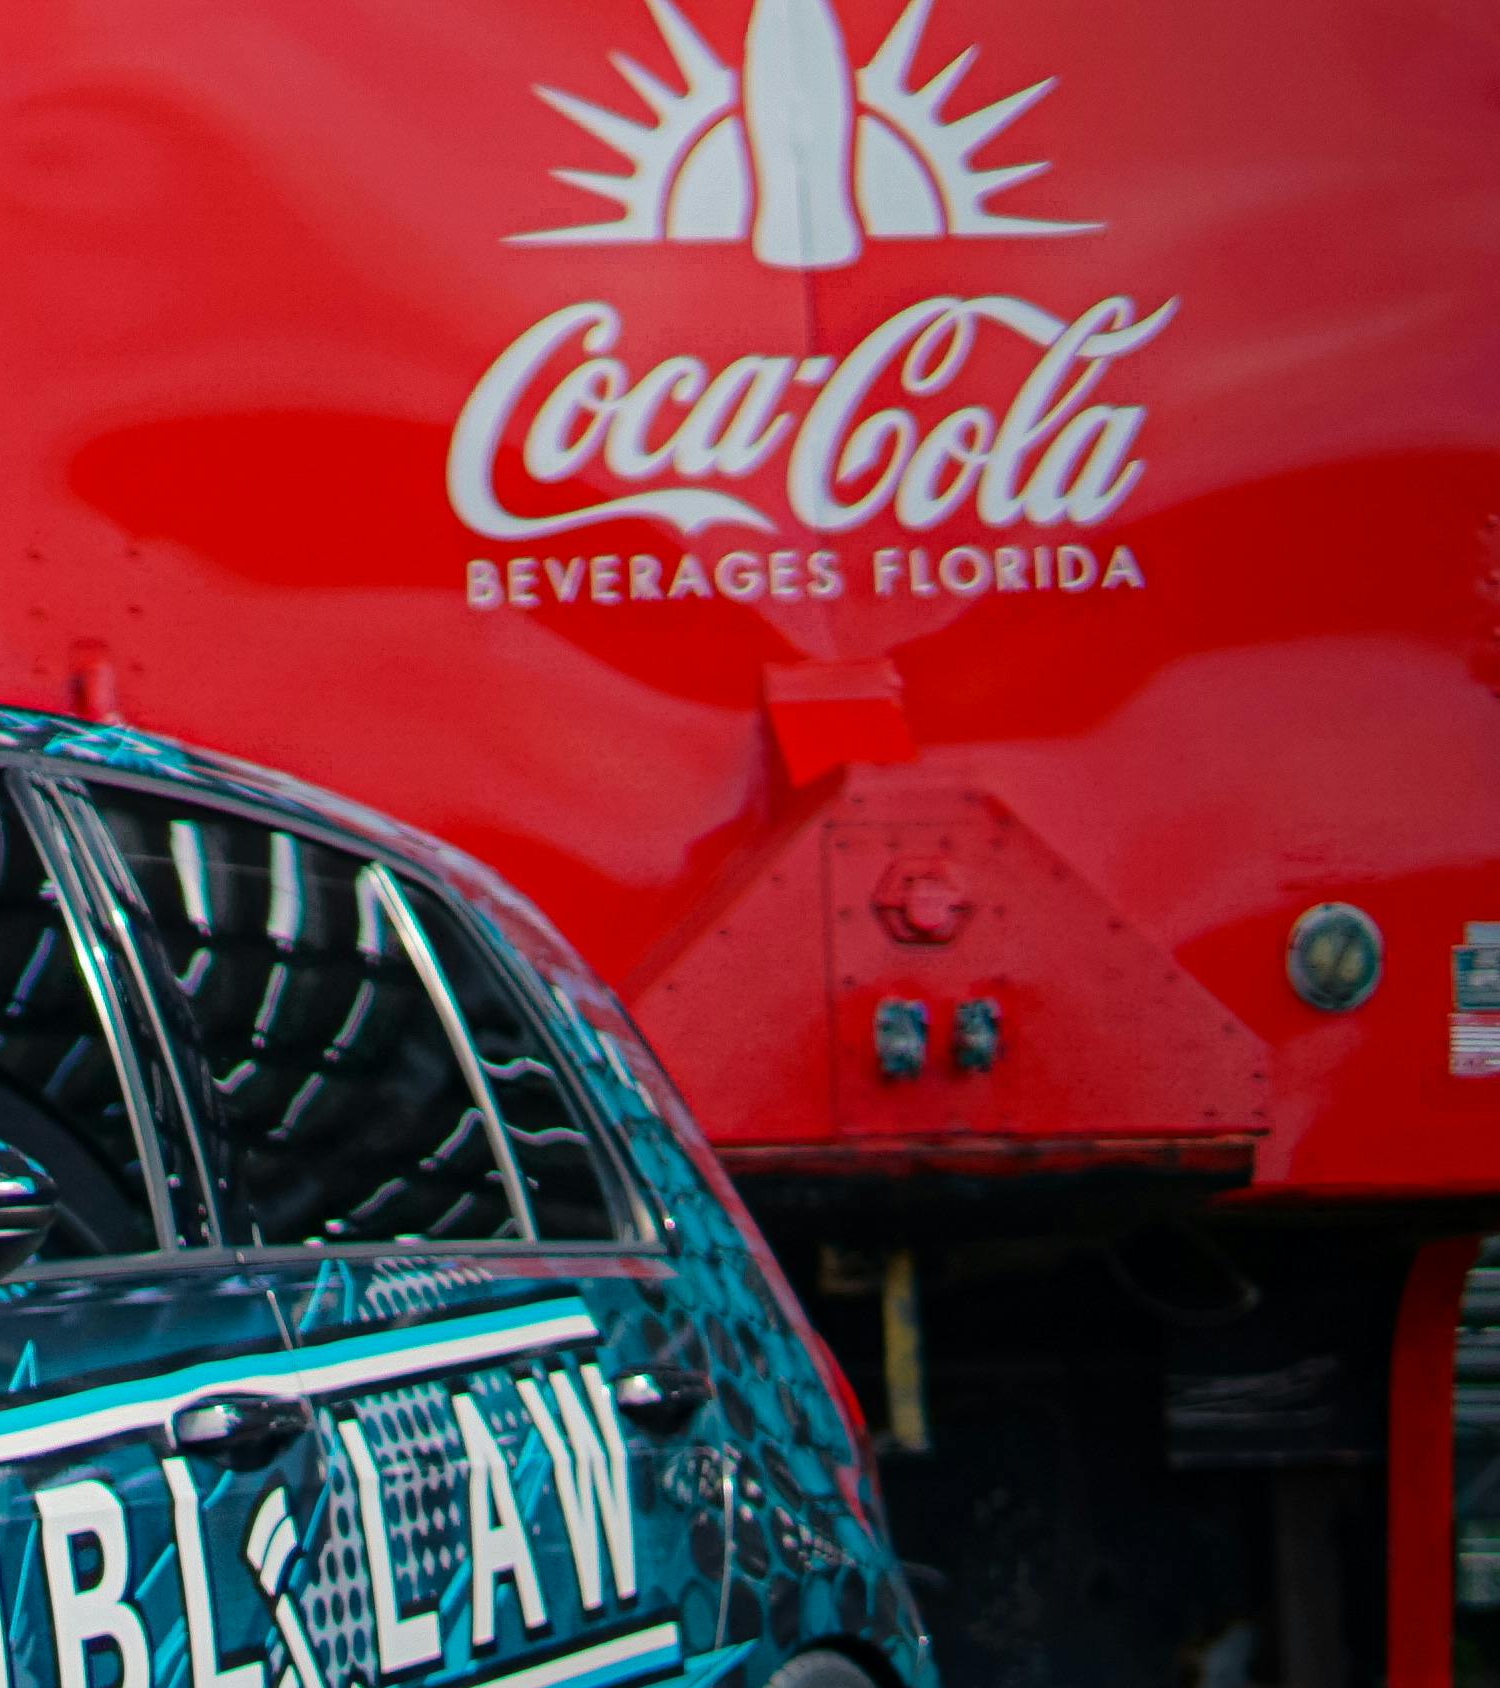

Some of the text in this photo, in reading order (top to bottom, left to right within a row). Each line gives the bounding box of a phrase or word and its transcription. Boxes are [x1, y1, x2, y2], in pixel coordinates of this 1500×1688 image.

[448, 298, 1180, 541] Coca-Cola
[466, 544, 1145, 610] BEVERAGES FLORIDA
[338, 1364, 638, 1668] LAW
